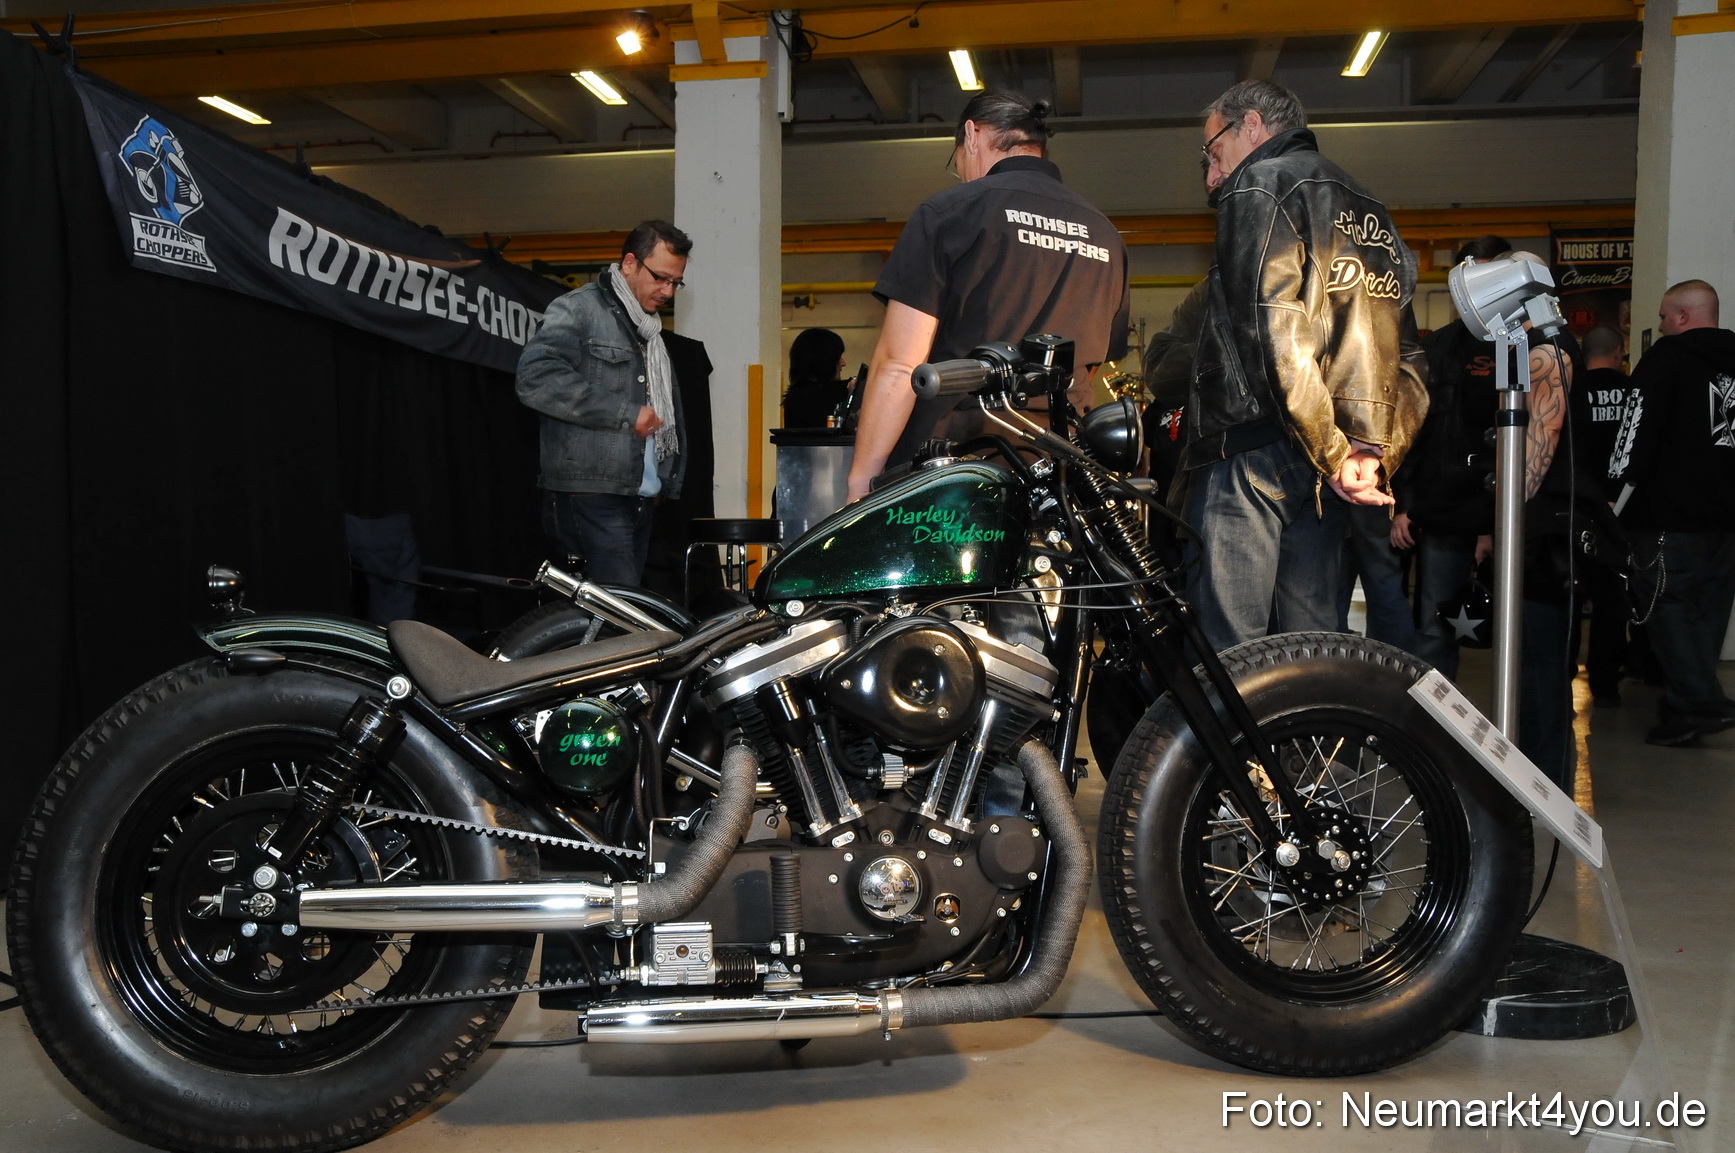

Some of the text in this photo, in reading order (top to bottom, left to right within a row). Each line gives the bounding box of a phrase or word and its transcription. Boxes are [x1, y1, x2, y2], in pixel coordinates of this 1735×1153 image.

[1005, 209, 1090, 239] ROTHSEE
[136, 237, 208, 265] CHOPPERS
[1017, 229, 1110, 263] CHOPPERS
[1563, 243, 1599, 260] HOUSE
[1601, 243, 1615, 259] OF
[1597, 388, 1626, 405] BO
[886, 505, 955, 526] Harley
[912, 522, 1005, 544] Davidson
[559, 733, 621, 752] green
[570, 752, 608, 767] one
